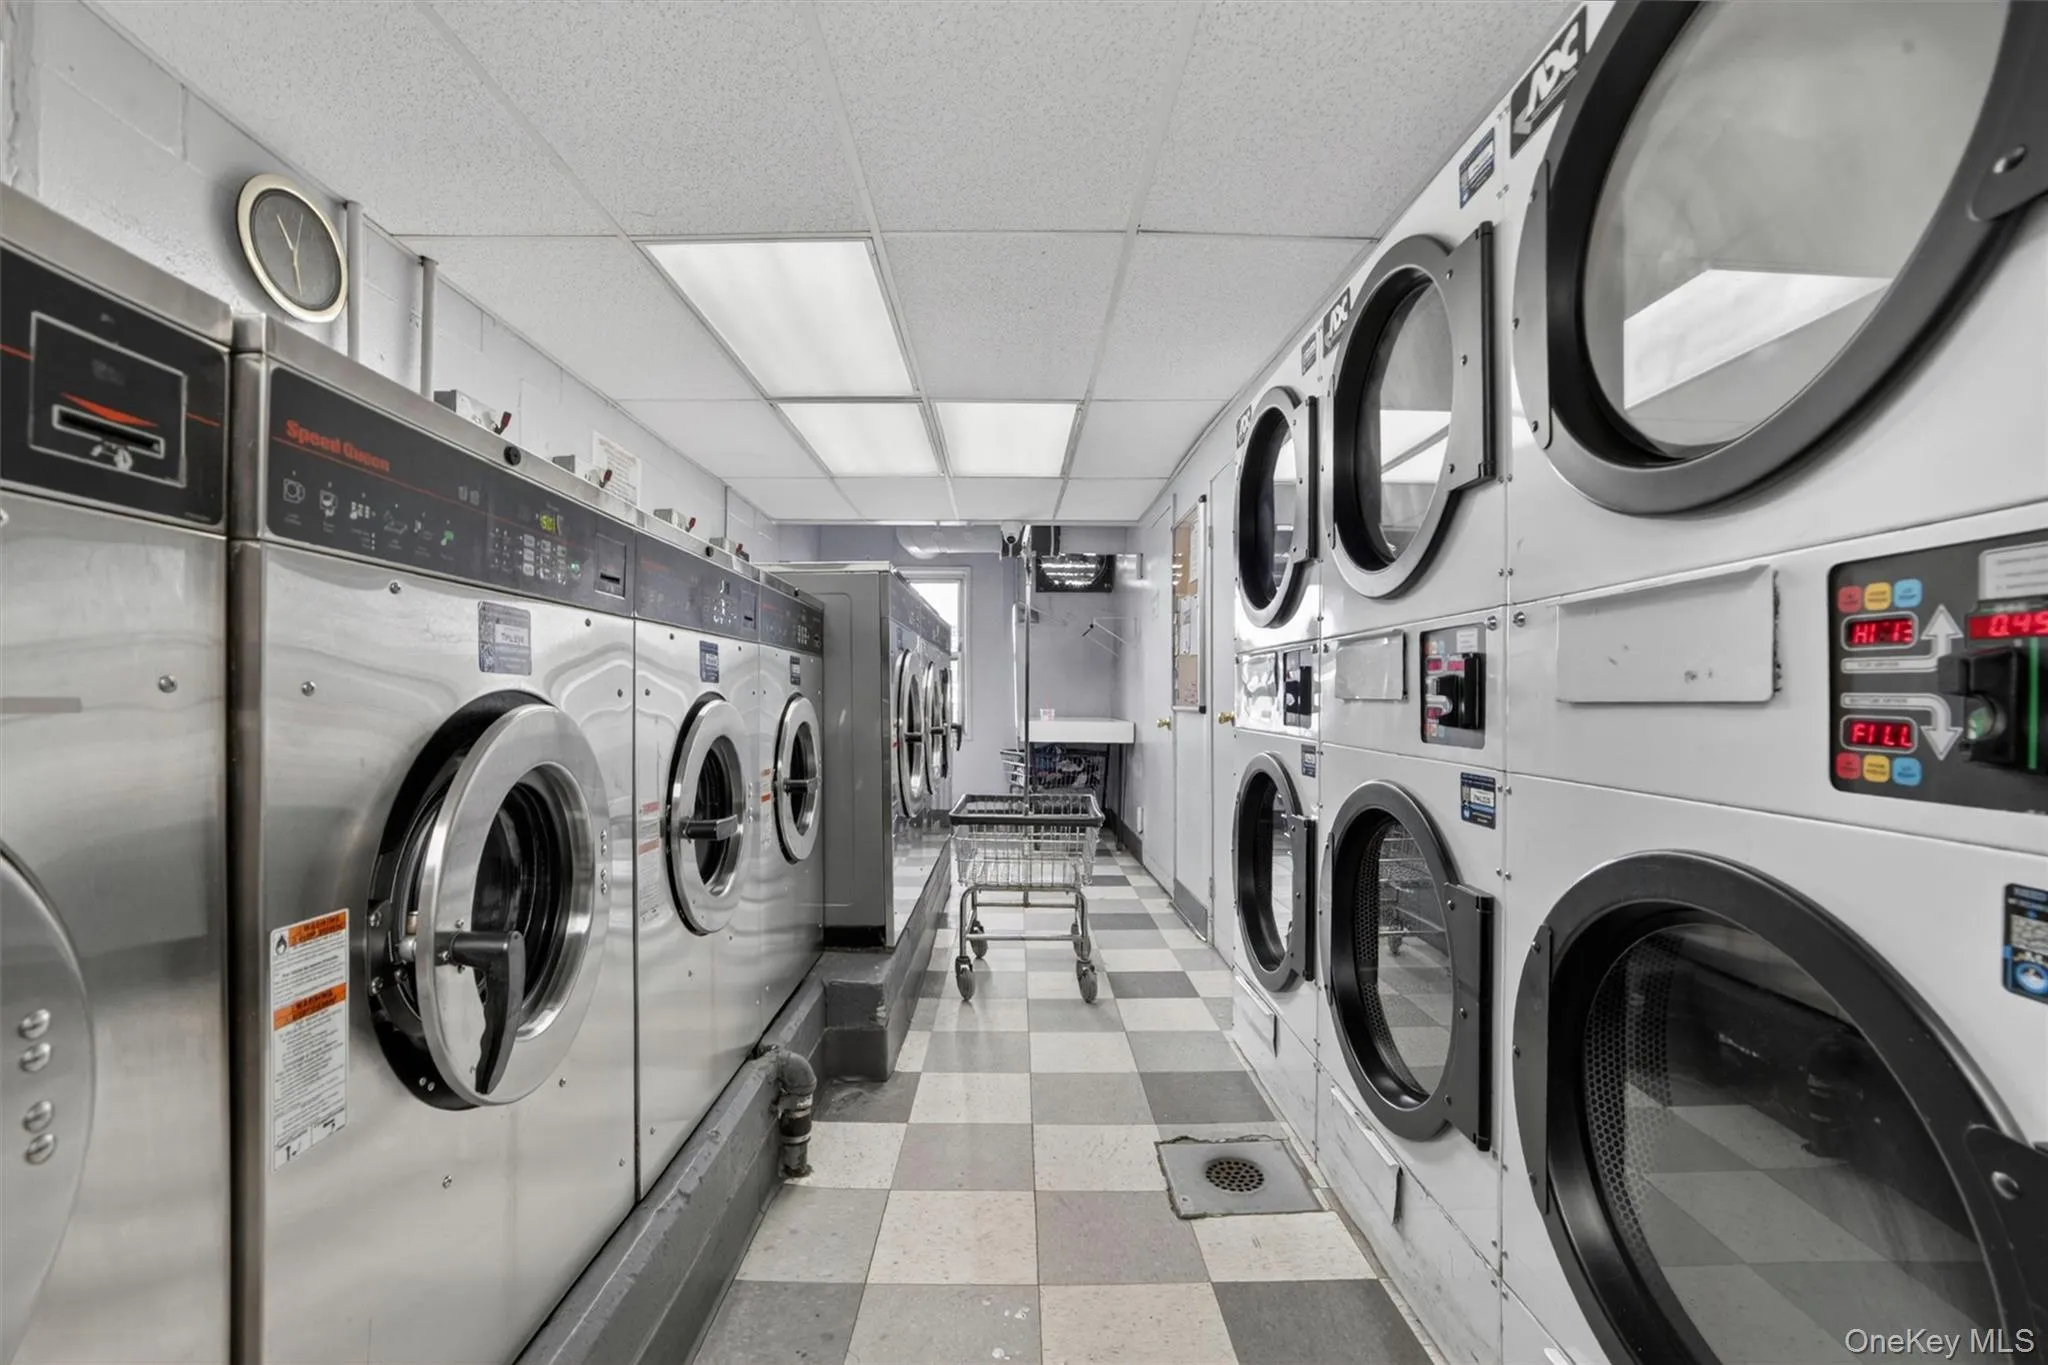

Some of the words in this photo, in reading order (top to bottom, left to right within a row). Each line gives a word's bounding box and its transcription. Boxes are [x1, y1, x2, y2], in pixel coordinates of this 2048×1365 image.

[286, 419, 341, 454] Speed
[342, 442, 390, 473] Queen
[1851, 722, 1913, 748] FILL
